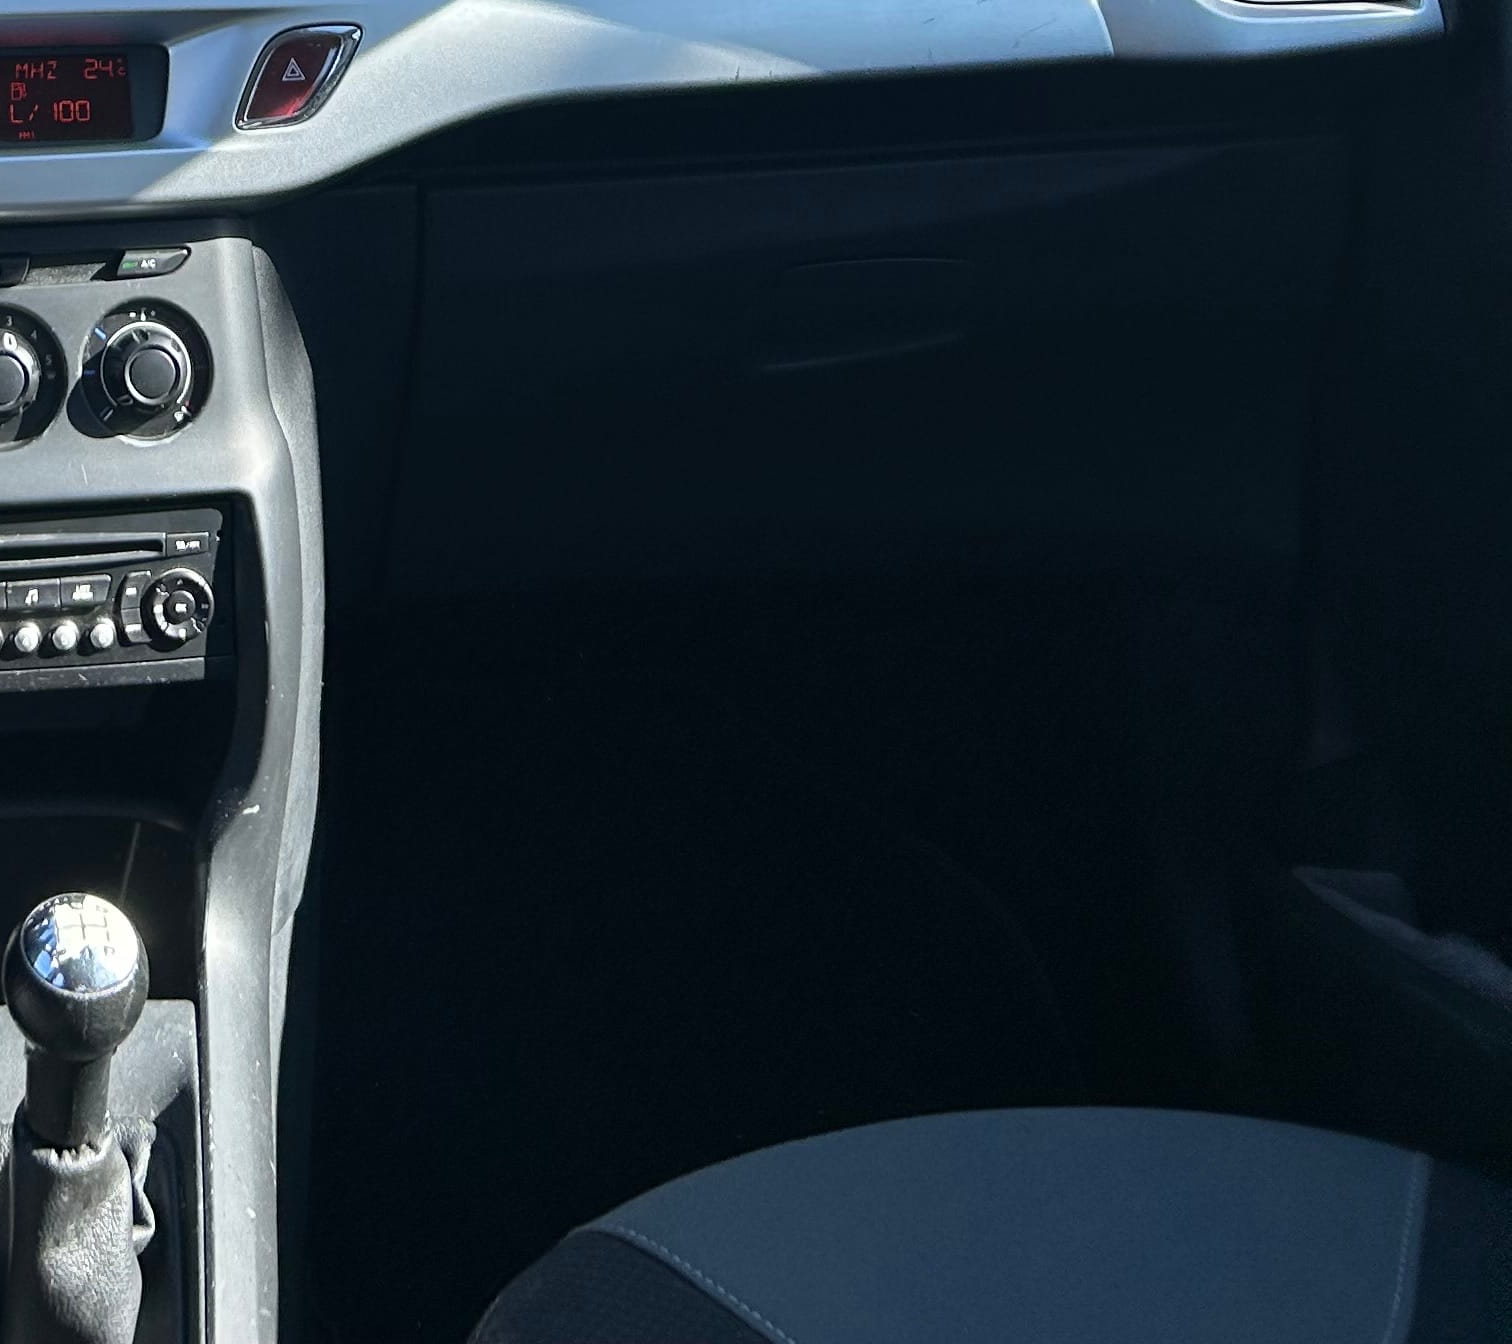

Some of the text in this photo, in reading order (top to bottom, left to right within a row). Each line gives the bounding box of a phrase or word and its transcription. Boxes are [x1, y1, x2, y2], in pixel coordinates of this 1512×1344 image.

[15, 62, 57, 81] MHZ
[6, 315, 13, 327] 3
[30, 329, 38, 341] 4
